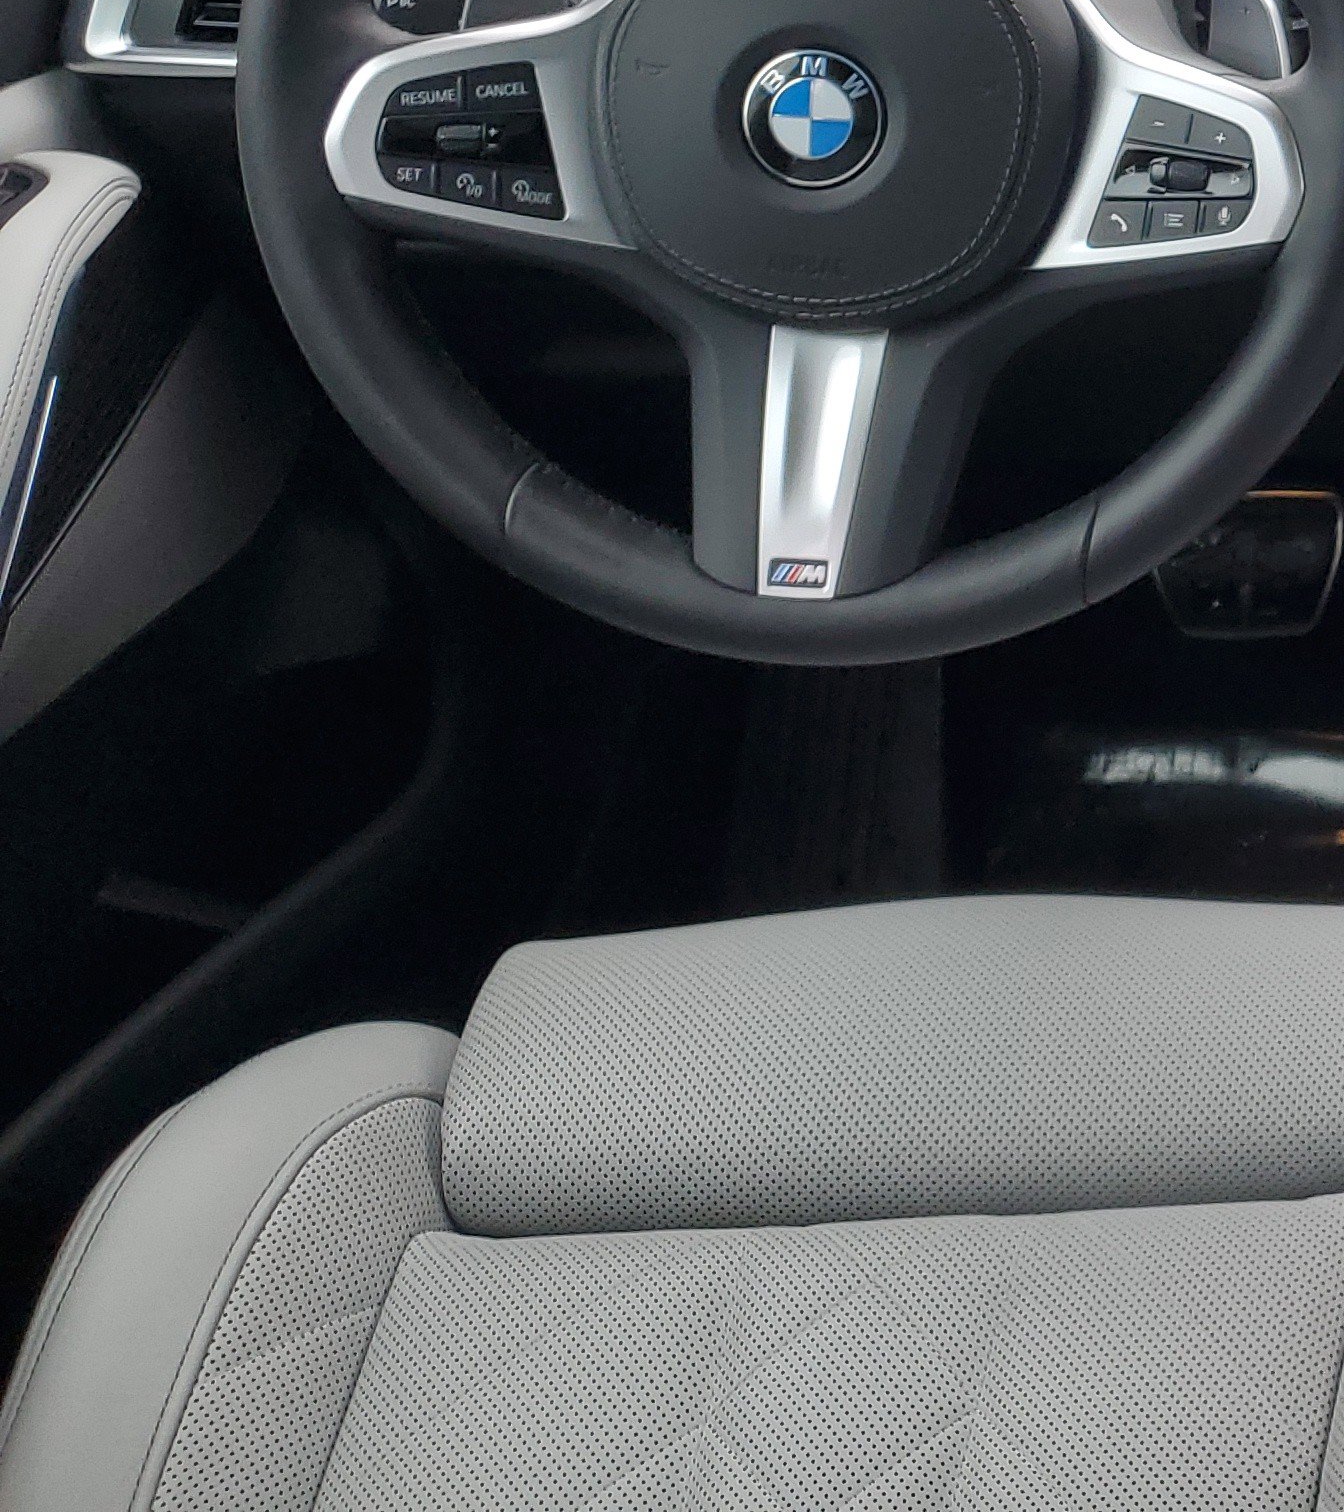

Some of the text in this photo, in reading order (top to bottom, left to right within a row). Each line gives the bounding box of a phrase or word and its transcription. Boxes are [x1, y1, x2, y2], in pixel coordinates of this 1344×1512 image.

[760, 55, 868, 100] BMW
[401, 81, 528, 107] RESUME CANCEL
[396, 166, 424, 182] SET
